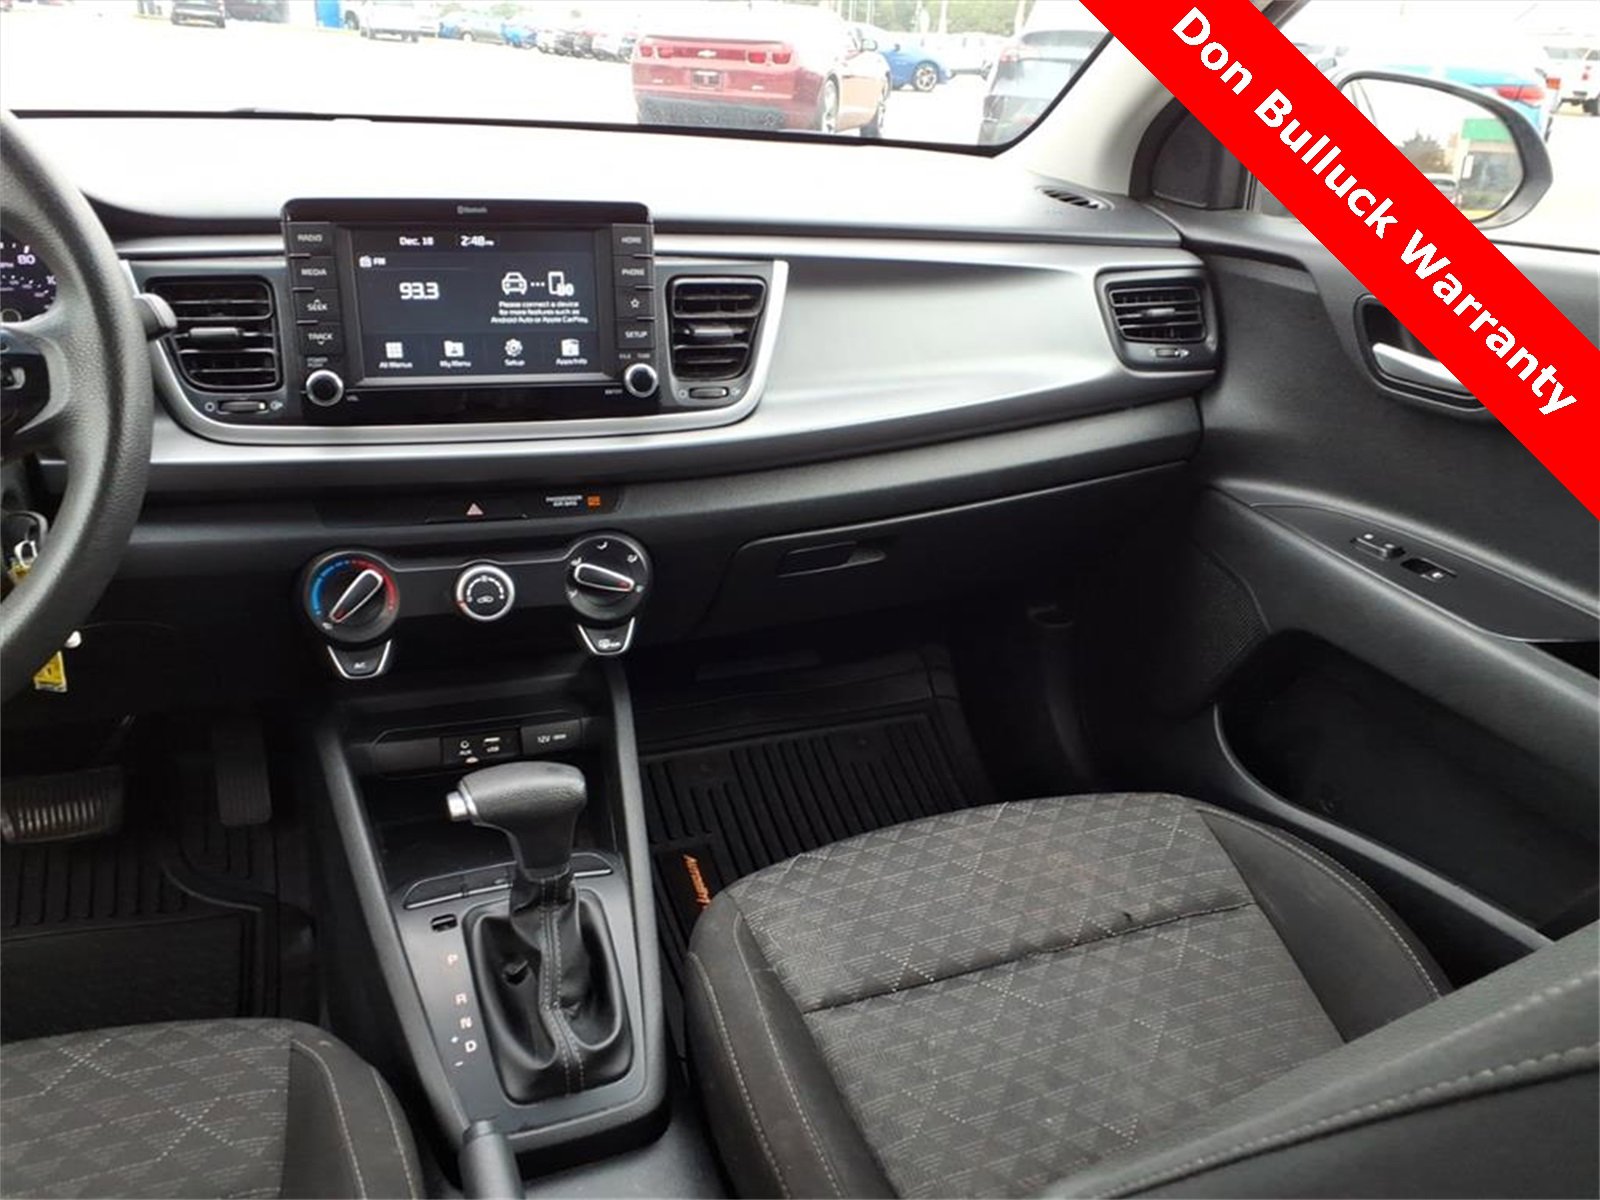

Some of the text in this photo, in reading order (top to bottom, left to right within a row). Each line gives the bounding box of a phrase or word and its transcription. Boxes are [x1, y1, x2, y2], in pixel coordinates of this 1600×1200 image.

[297, 234, 323, 242] RADIO
[400, 237, 420, 246] Dec.
[621, 236, 642, 244] HOME
[17, 254, 36, 265] 80
[301, 268, 327, 276] MEDIA
[622, 268, 645, 277] PHONE
[400, 282, 440, 299] 93.3
[306, 303, 328, 312] SEEK
[308, 333, 333, 341] TRACK
[625, 330, 648, 339] SETUP
[537, 735, 551, 744] 12V
[447, 953, 458, 964] P
[456, 993, 467, 1004] R
[460, 1017, 472, 1028] N
[465, 1039, 477, 1052] D
